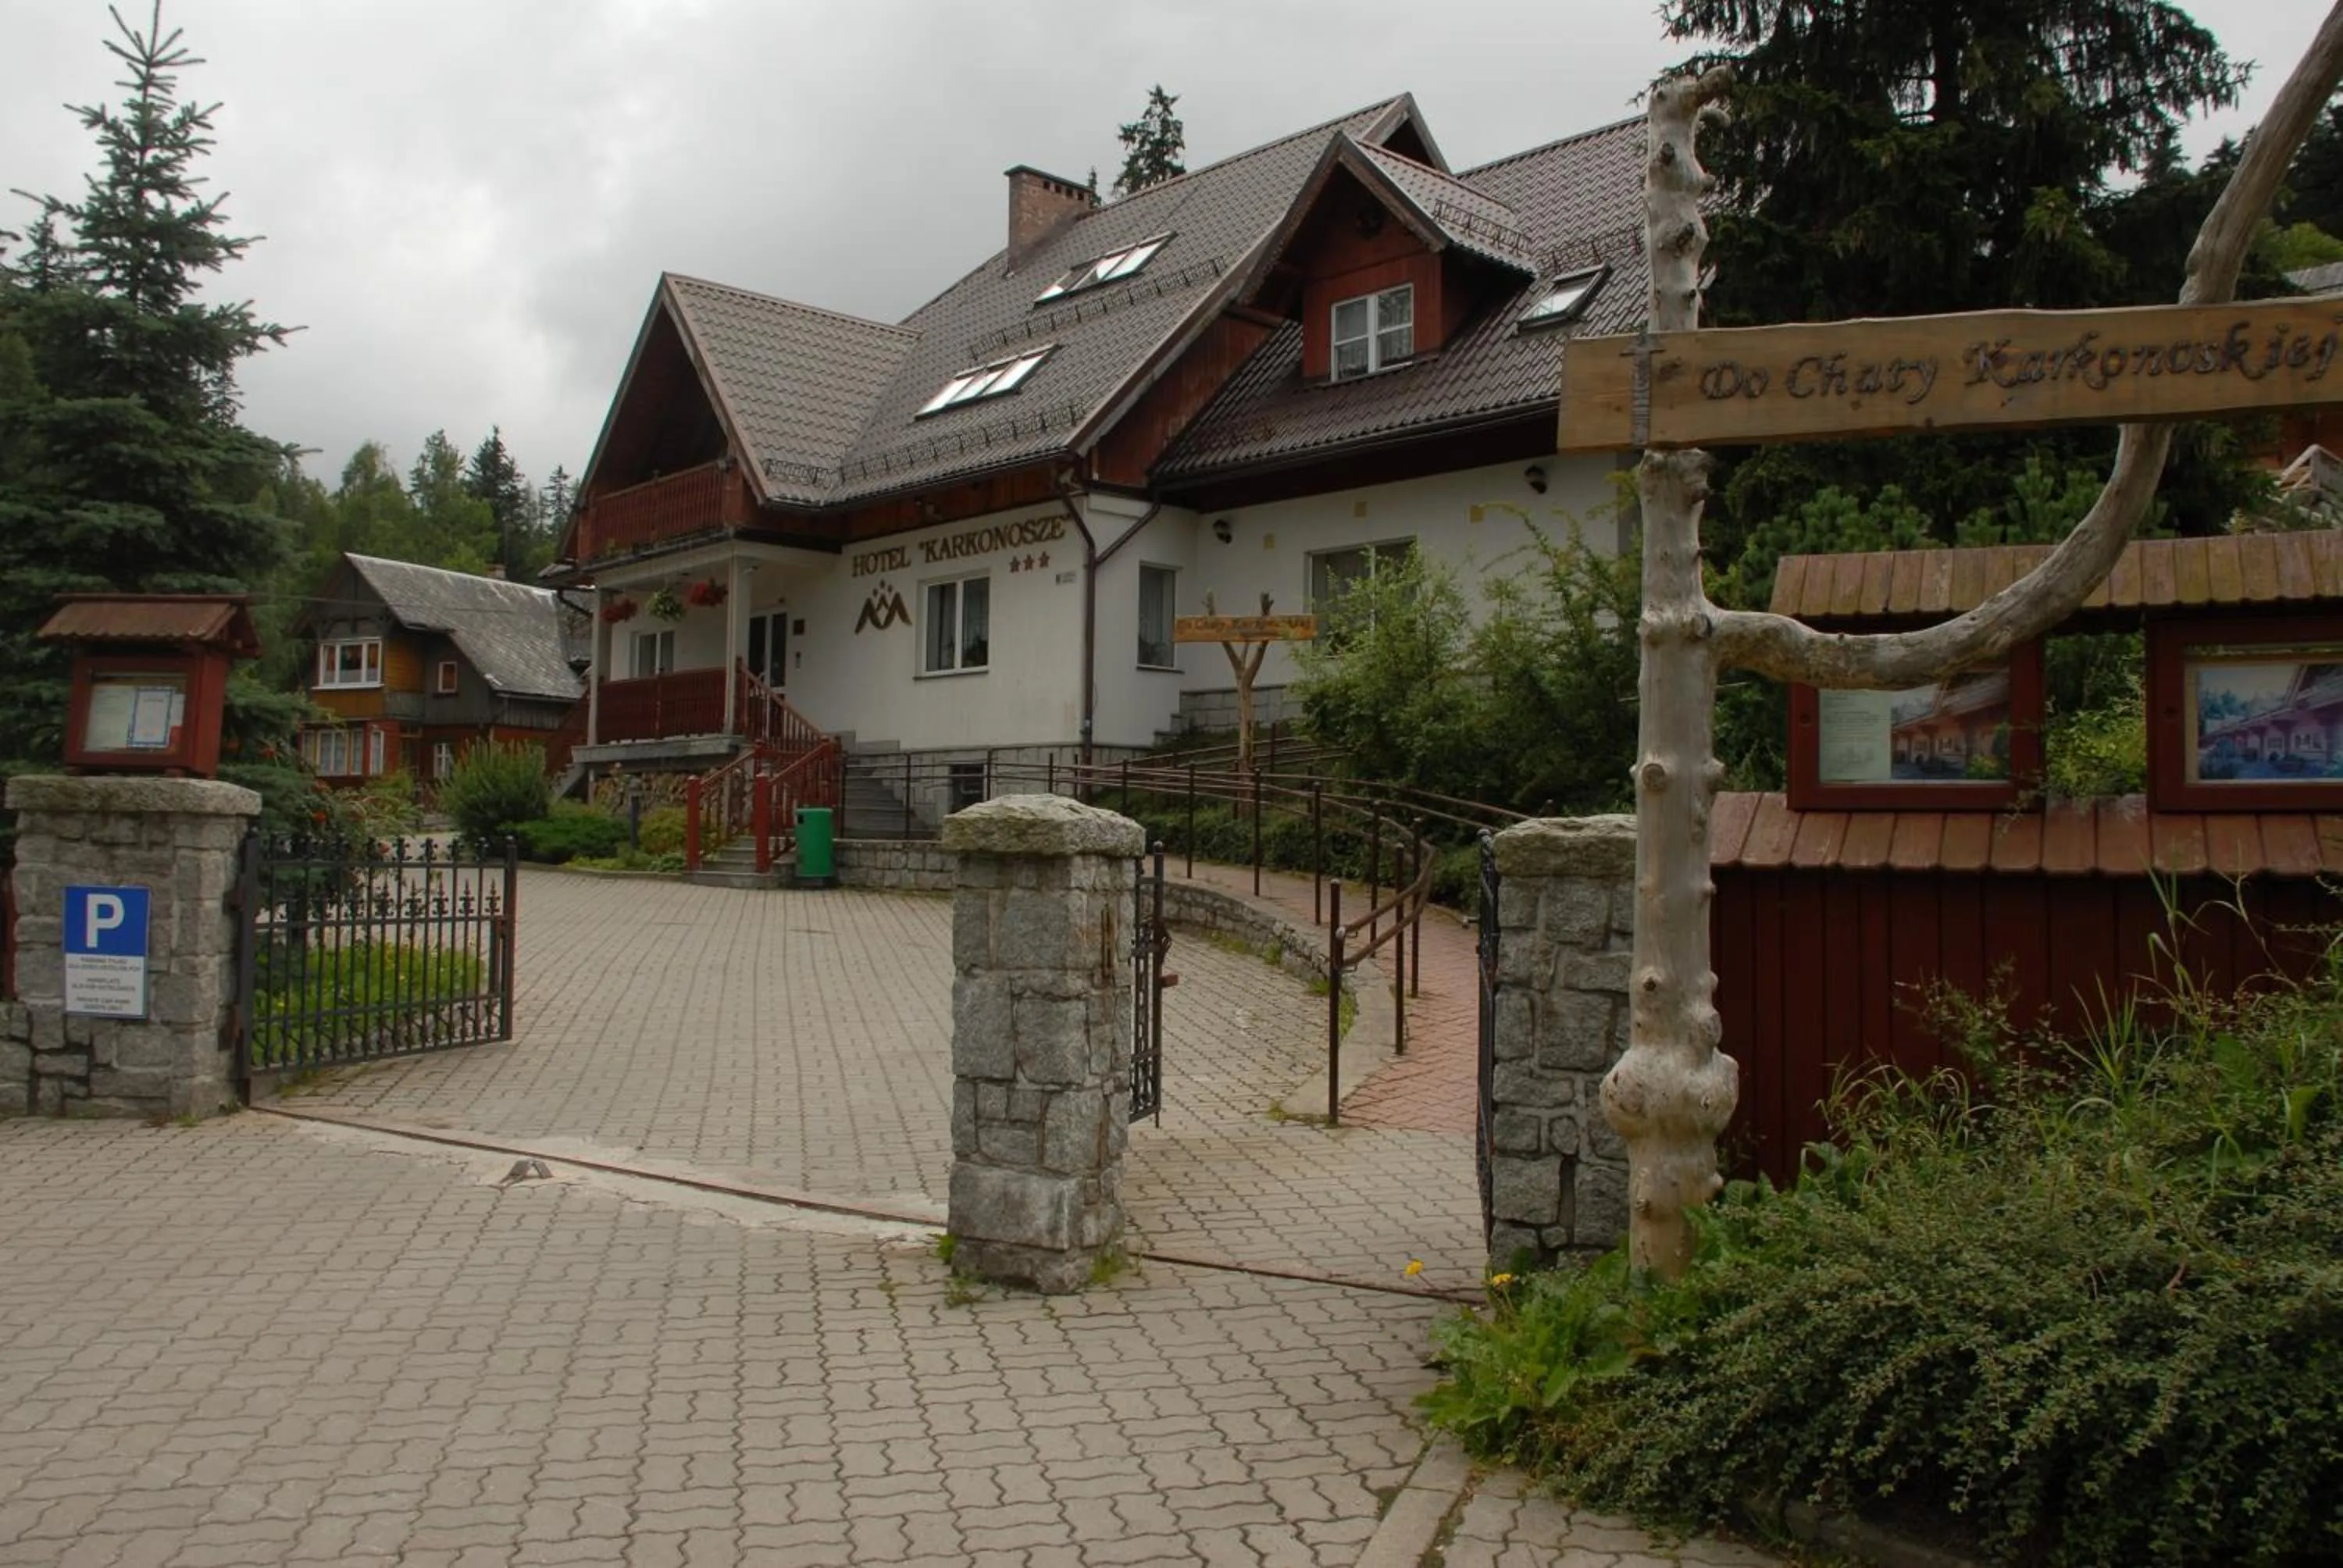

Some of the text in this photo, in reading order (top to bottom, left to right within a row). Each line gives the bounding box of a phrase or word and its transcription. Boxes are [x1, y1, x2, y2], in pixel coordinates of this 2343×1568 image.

[1698, 359, 1771, 401] Do
[1961, 314, 2343, 390] Karkonoskiej
[852, 546, 912, 578] HOTEL
[87, 893, 125, 949] P
